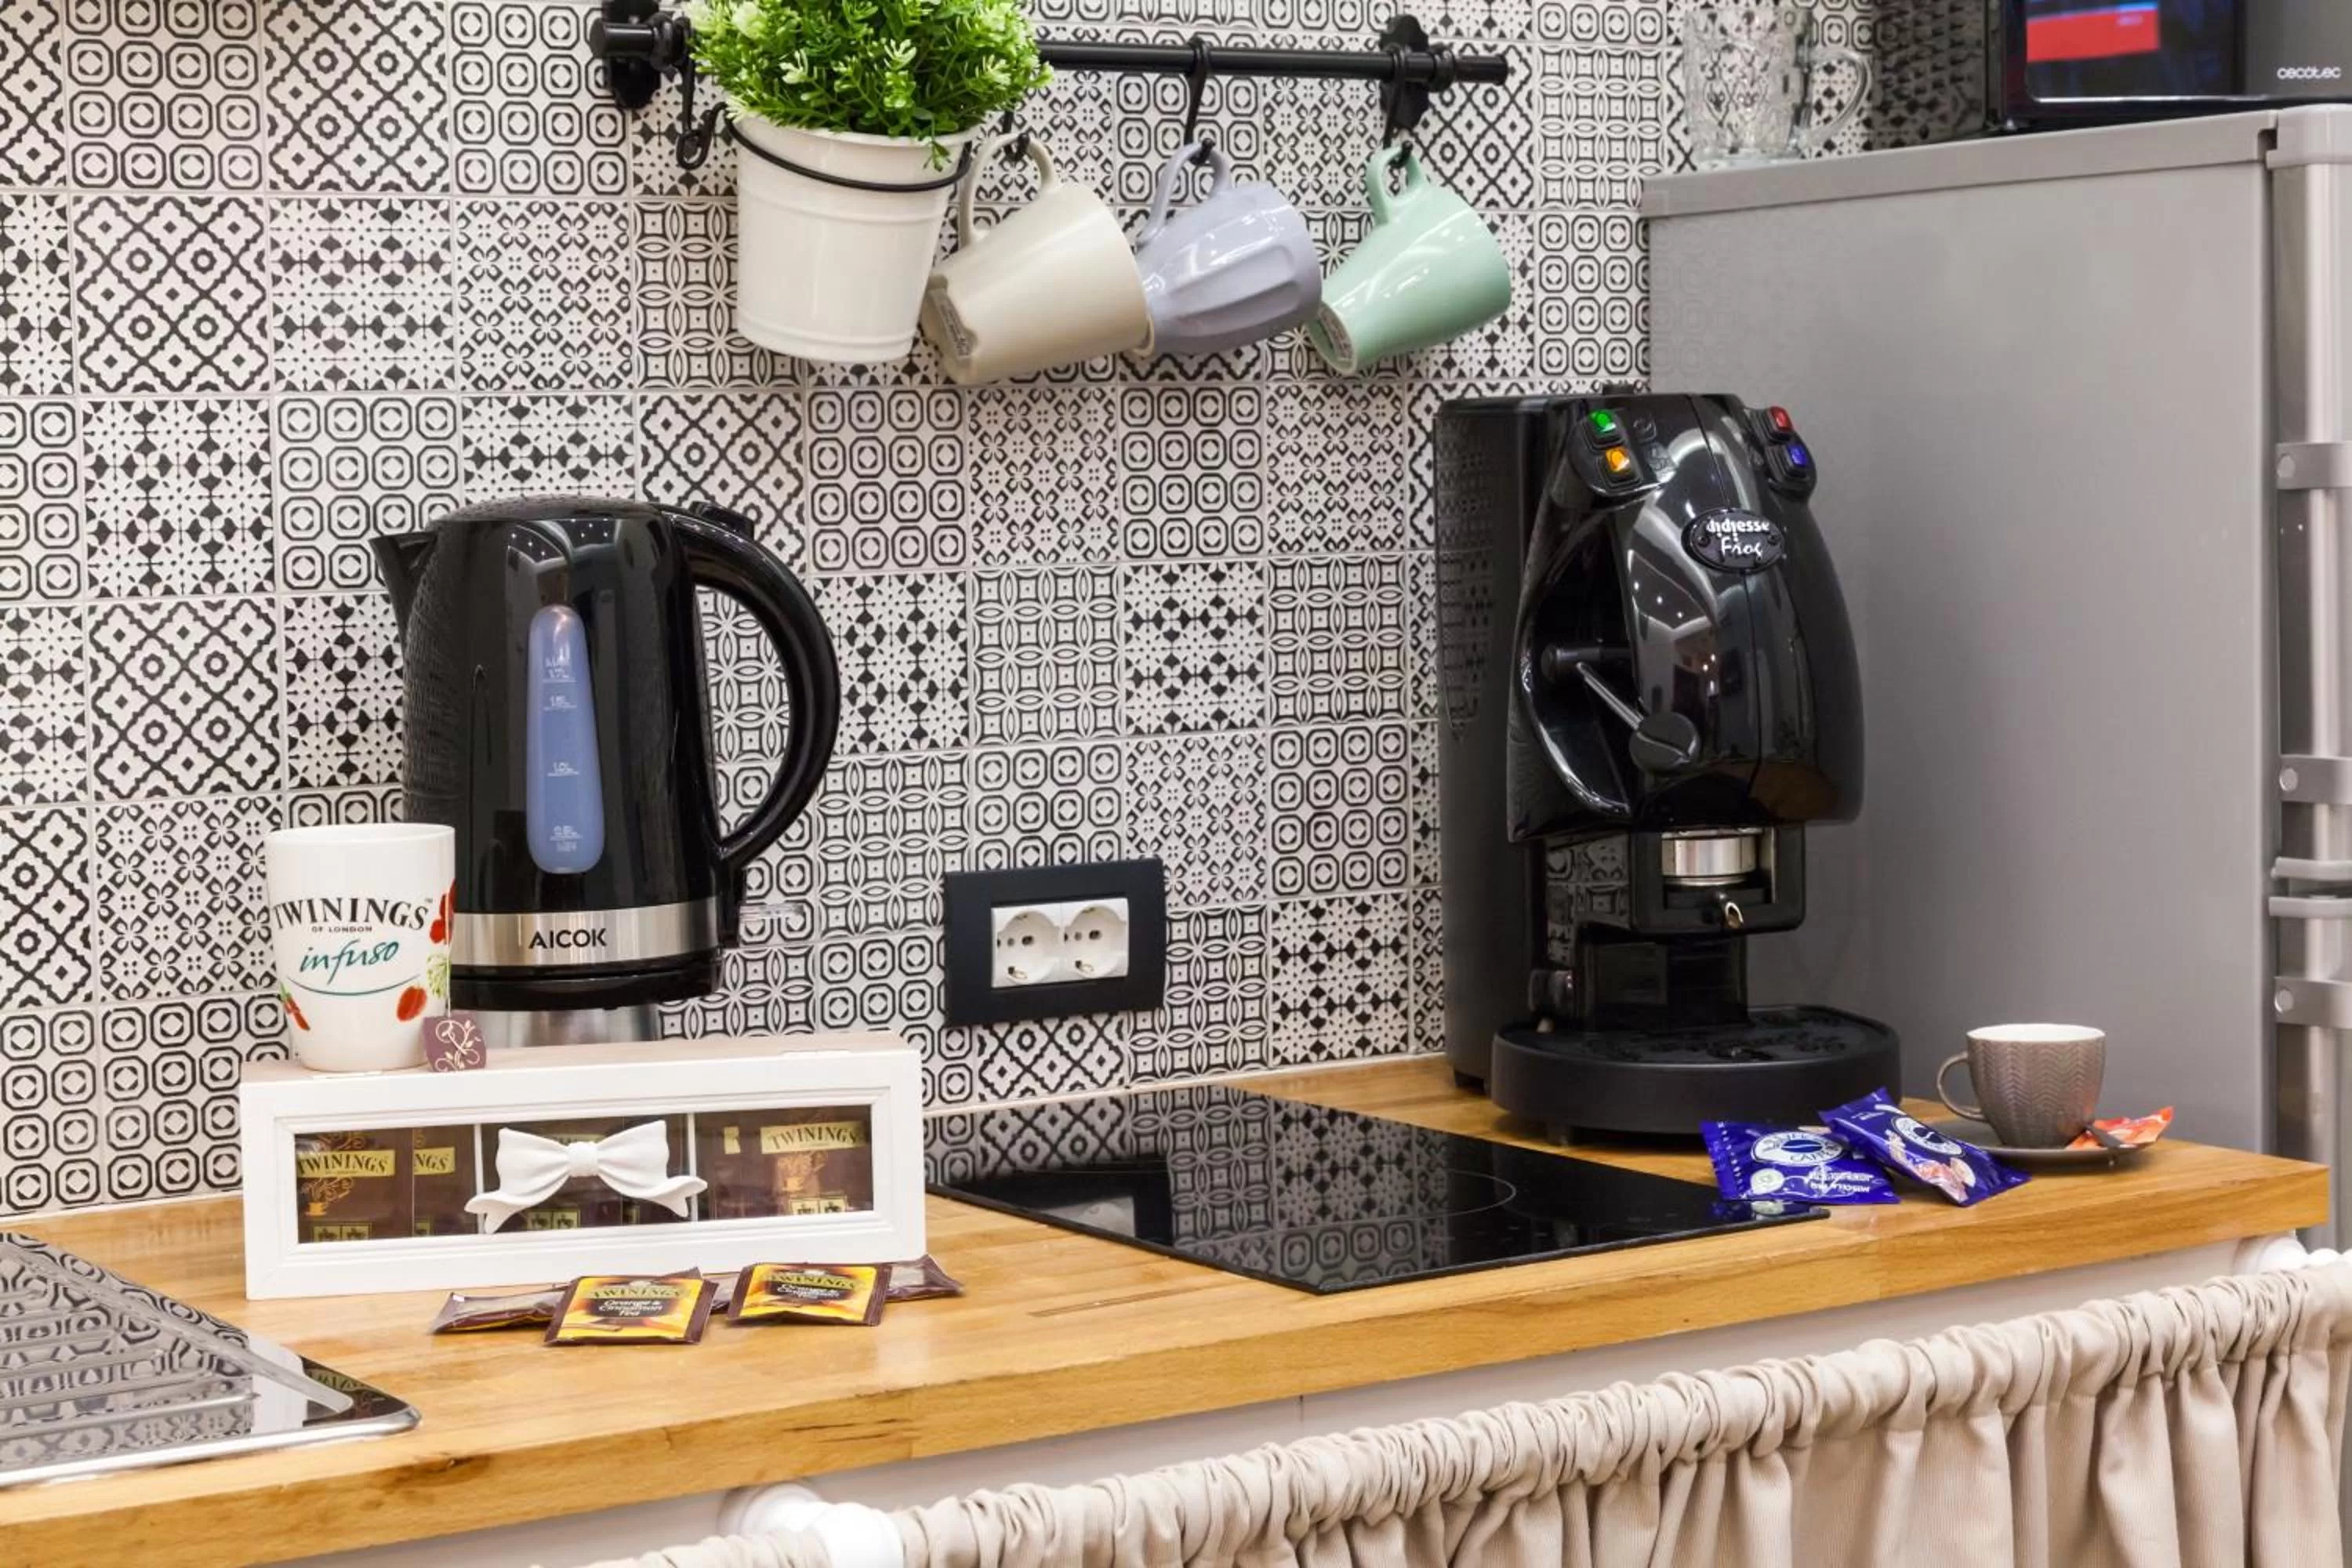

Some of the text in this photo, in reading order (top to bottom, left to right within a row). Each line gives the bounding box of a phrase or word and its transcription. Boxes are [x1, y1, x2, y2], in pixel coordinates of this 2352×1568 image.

[2277, 67, 2341, 79] cecotec
[274, 897, 429, 931] TWININGS
[528, 928, 608, 949] AICOK
[299, 938, 399, 986] infuso
[770, 1127, 858, 1150] TWININGS
[296, 1153, 388, 1174] TWININGS
